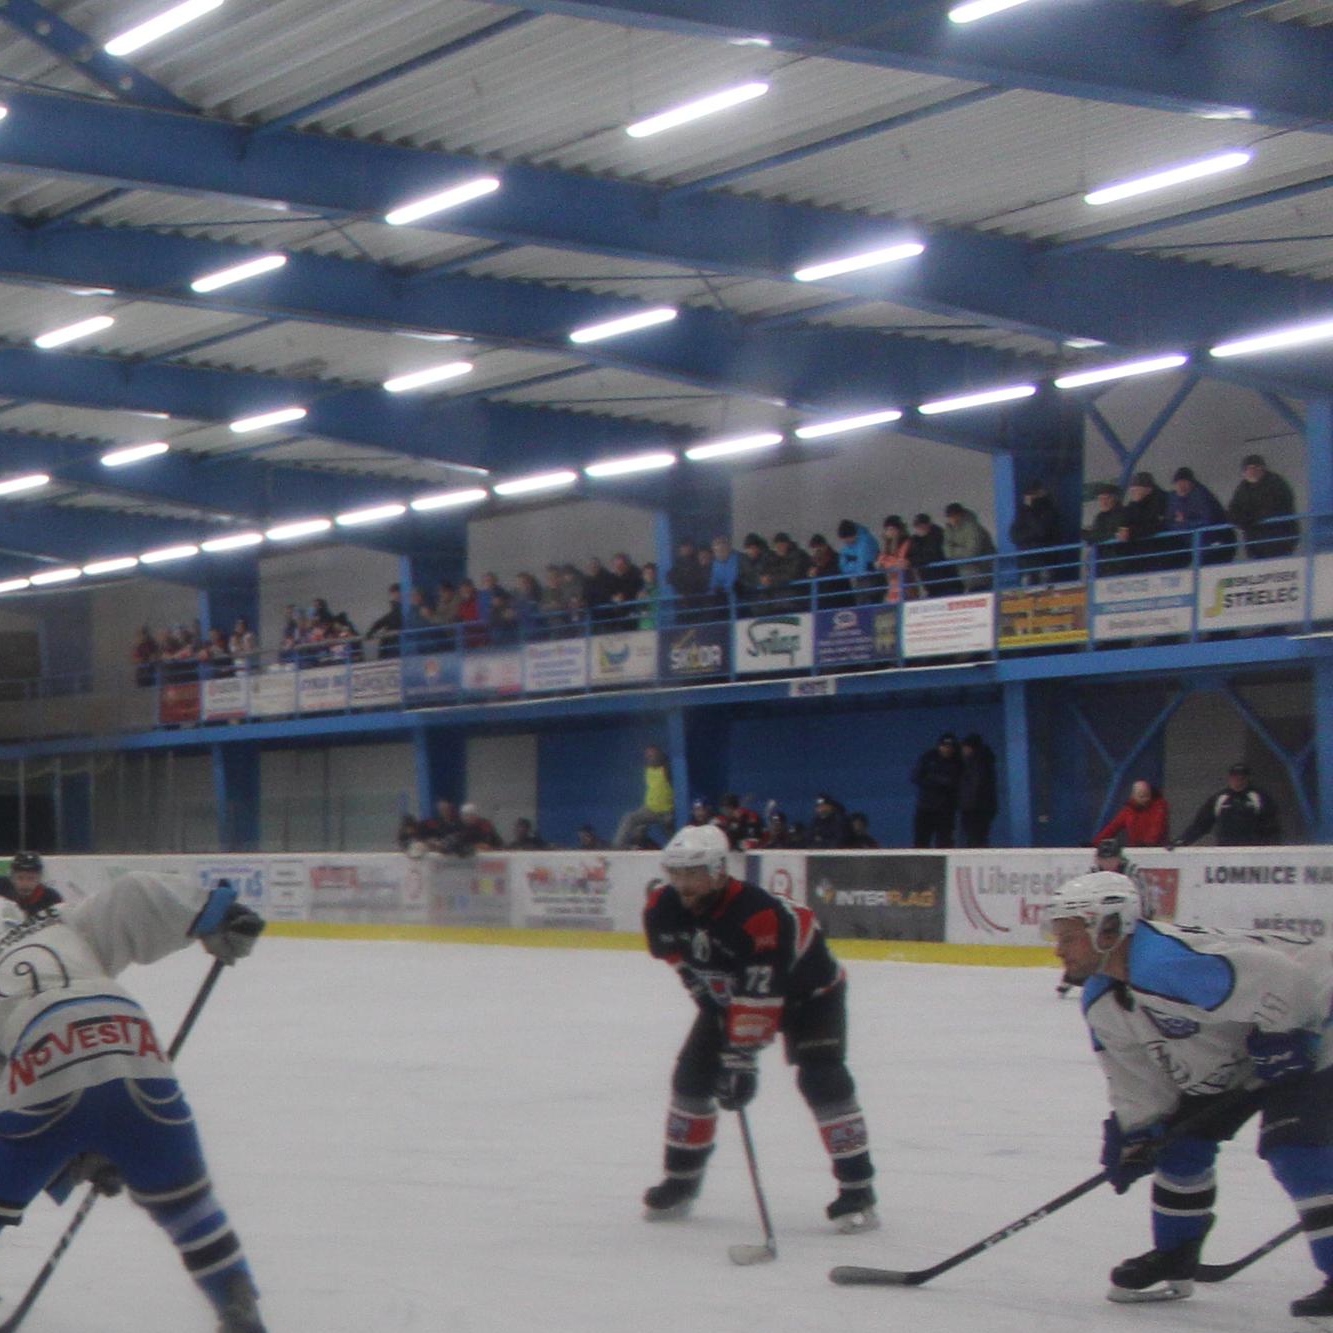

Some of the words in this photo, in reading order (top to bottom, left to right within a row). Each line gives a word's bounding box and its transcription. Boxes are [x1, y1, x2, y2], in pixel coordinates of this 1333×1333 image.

[1204, 865, 1297, 884] LOMNICE
[745, 965, 773, 994] 72
[9, 1014, 165, 1095] NOVESTA
